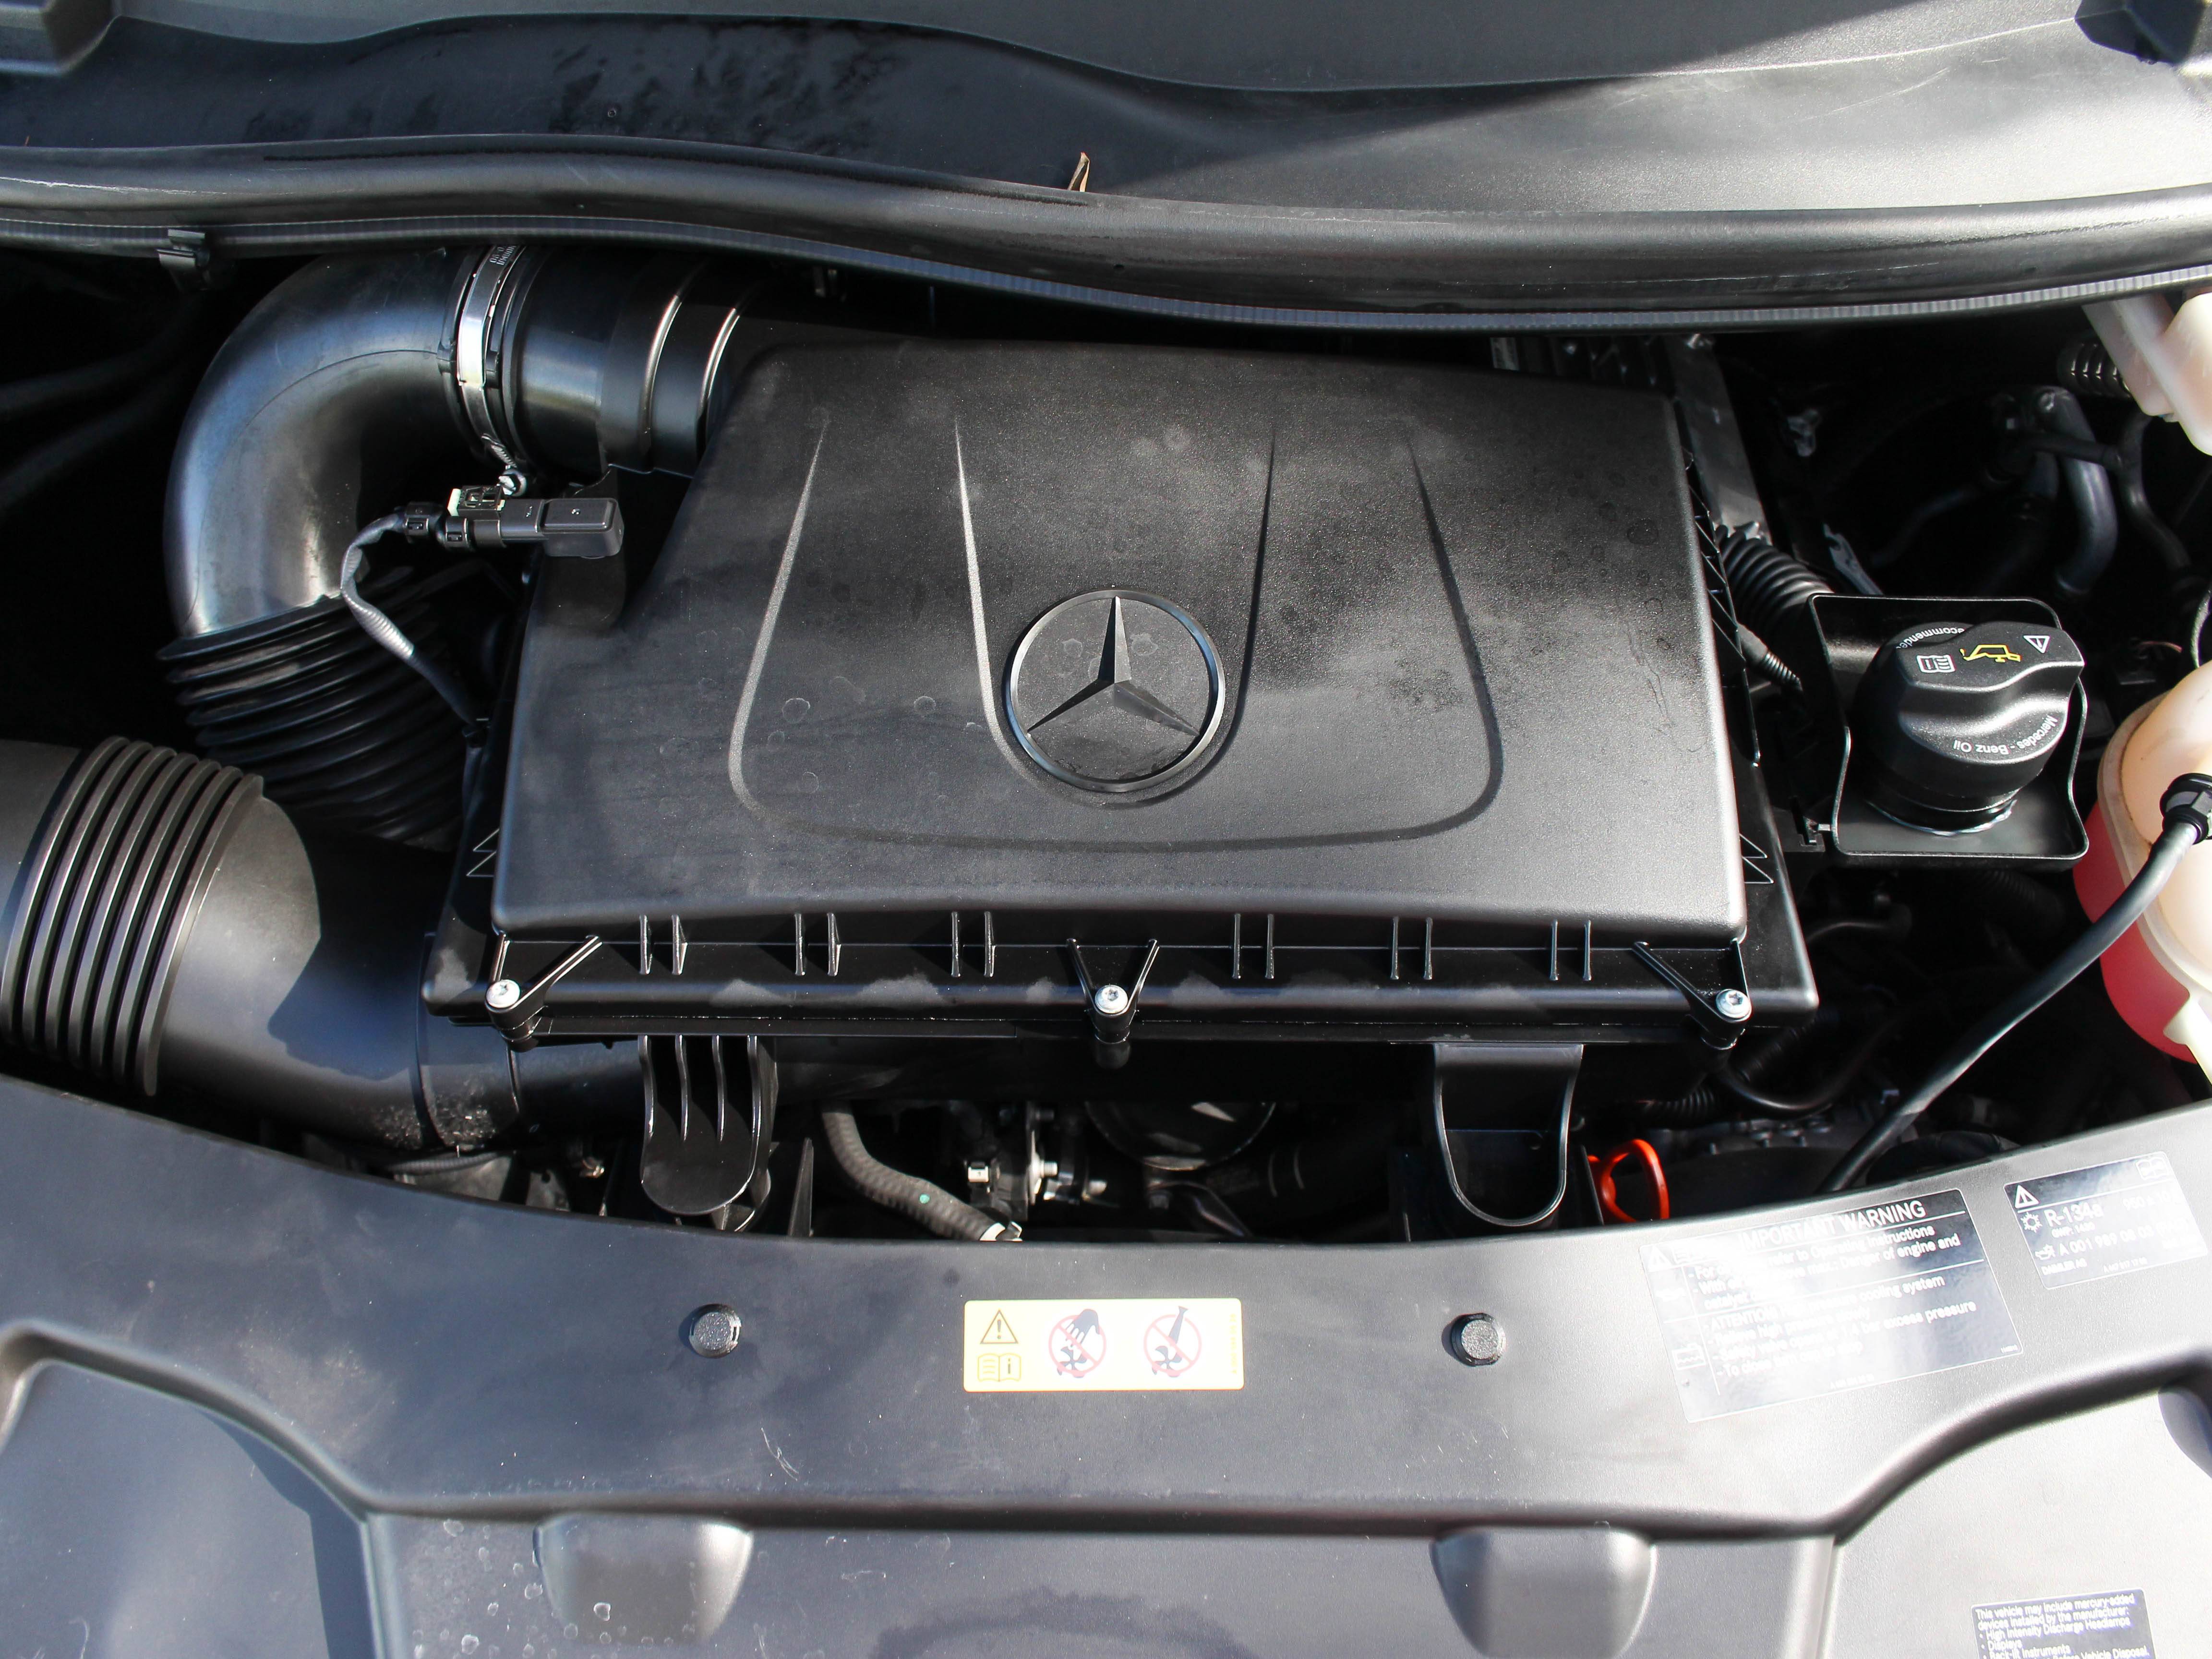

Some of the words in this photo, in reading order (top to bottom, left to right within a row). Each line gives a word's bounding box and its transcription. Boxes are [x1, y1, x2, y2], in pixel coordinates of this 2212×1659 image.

[2016, 714, 2058, 749] Mercedes
[1953, 739, 1972, 753] Oil
[1975, 744, 2009, 755] Benz
[1739, 1216, 1836, 1250] IMPORTANT
[1838, 1200, 1927, 1232] WARNING
[2044, 1202, 2104, 1227] R-134a
[2059, 1242, 2069, 1256] A
[2069, 1237, 2093, 1253] 001
[1694, 1265, 1714, 1279] For
[1795, 1249, 1809, 1262] to
[1698, 1278, 1727, 1295] With
[1839, 1252, 1880, 1269] Danger
[1883, 1247, 1896, 1260] of
[1897, 1240, 1936, 1258] engine
[1937, 1233, 1961, 1249] and
[1859, 1284, 1903, 1301] cooling
[1902, 1275, 1946, 1296] system
[1859, 1318, 1881, 1334] bar
[1883, 1311, 1924, 1330] excess
[1924, 1300, 1977, 1324] pressure
[1723, 1362, 1740, 1378] To
[1821, 1344, 1836, 1358] to
[1974, 1608, 1993, 1620] This
[1994, 1605, 2023, 1618] vehicle
[2024, 1605, 2042, 1616] may
[2074, 1592, 2136, 1609] mercury-added
[1977, 1619, 2009, 1631] devices
[2010, 1613, 2045, 1628] installed
[2045, 1613, 2056, 1625] by
[2057, 1611, 2072, 1623] the
[2072, 1606, 2130, 1621] manufacturer:
[1985, 1628, 2006, 1642] High
[2007, 1625, 2042, 1638] Intensity
[2043, 1620, 2084, 1635] Discharge
[2084, 1616, 2131, 1631] Headlamps
[1987, 1639, 2023, 1652] Displays
[2021, 1644, 2071, 1659] Instruments
